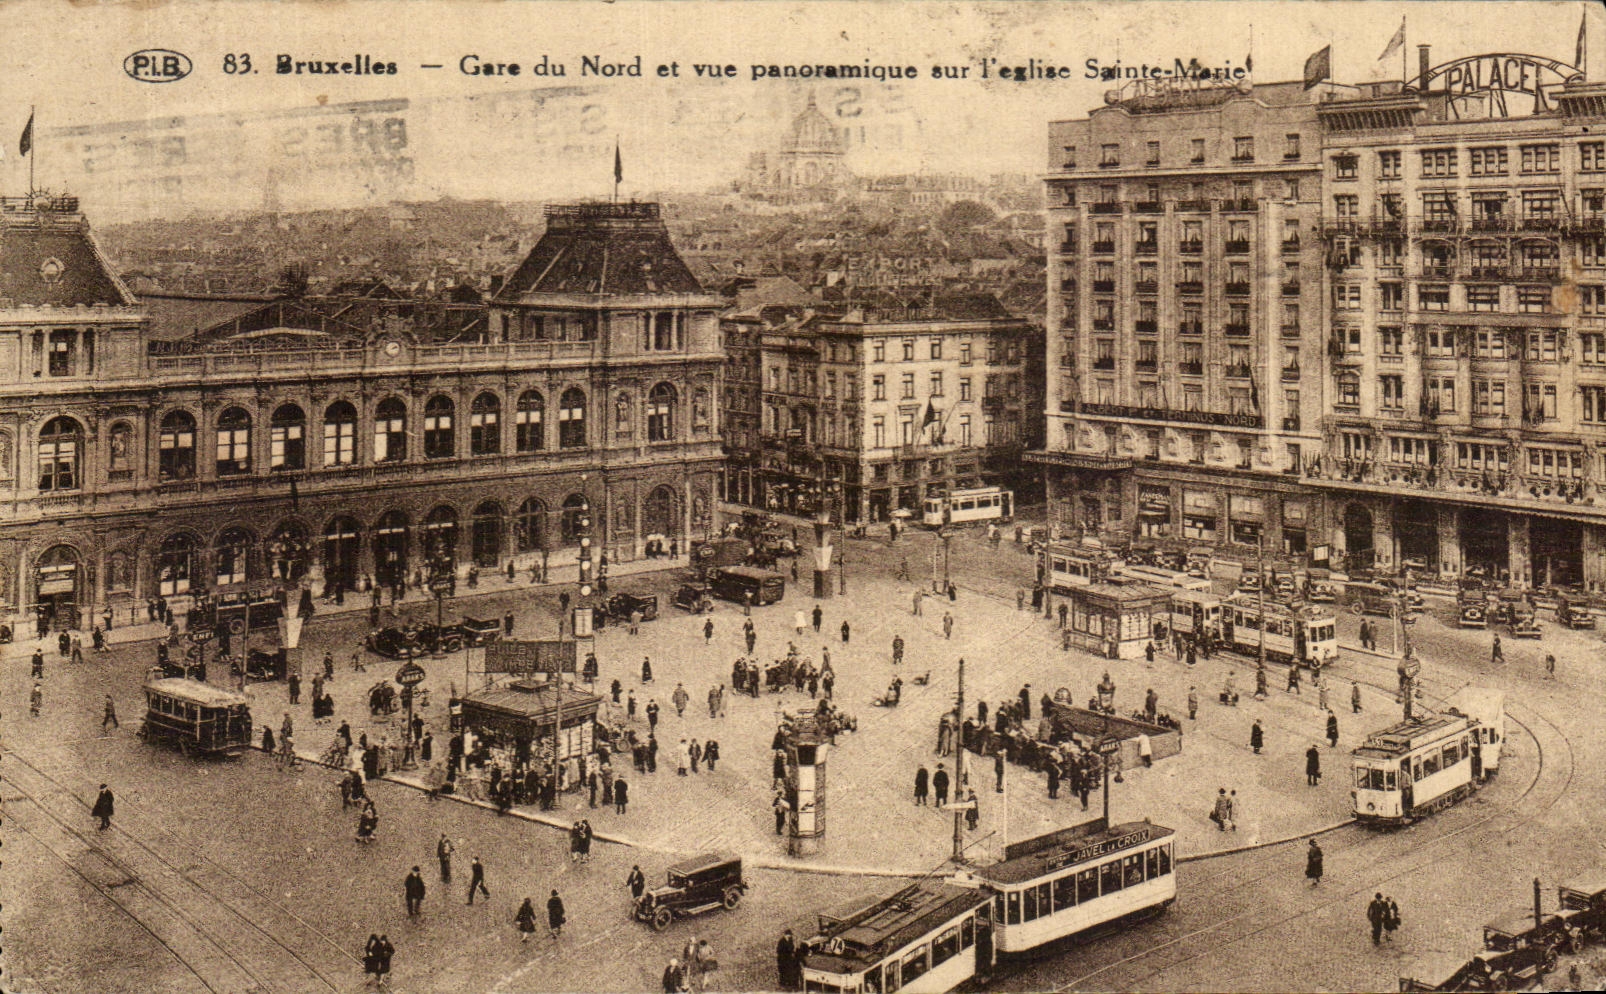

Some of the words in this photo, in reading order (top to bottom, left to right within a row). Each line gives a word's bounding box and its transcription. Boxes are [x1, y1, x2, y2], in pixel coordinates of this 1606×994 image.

[1448, 58, 1535, 94] PALACE
[1223, 415, 1257, 428] NORD
[1074, 845, 1105, 862] JAVEL
[1118, 830, 1147, 848] CROIX
